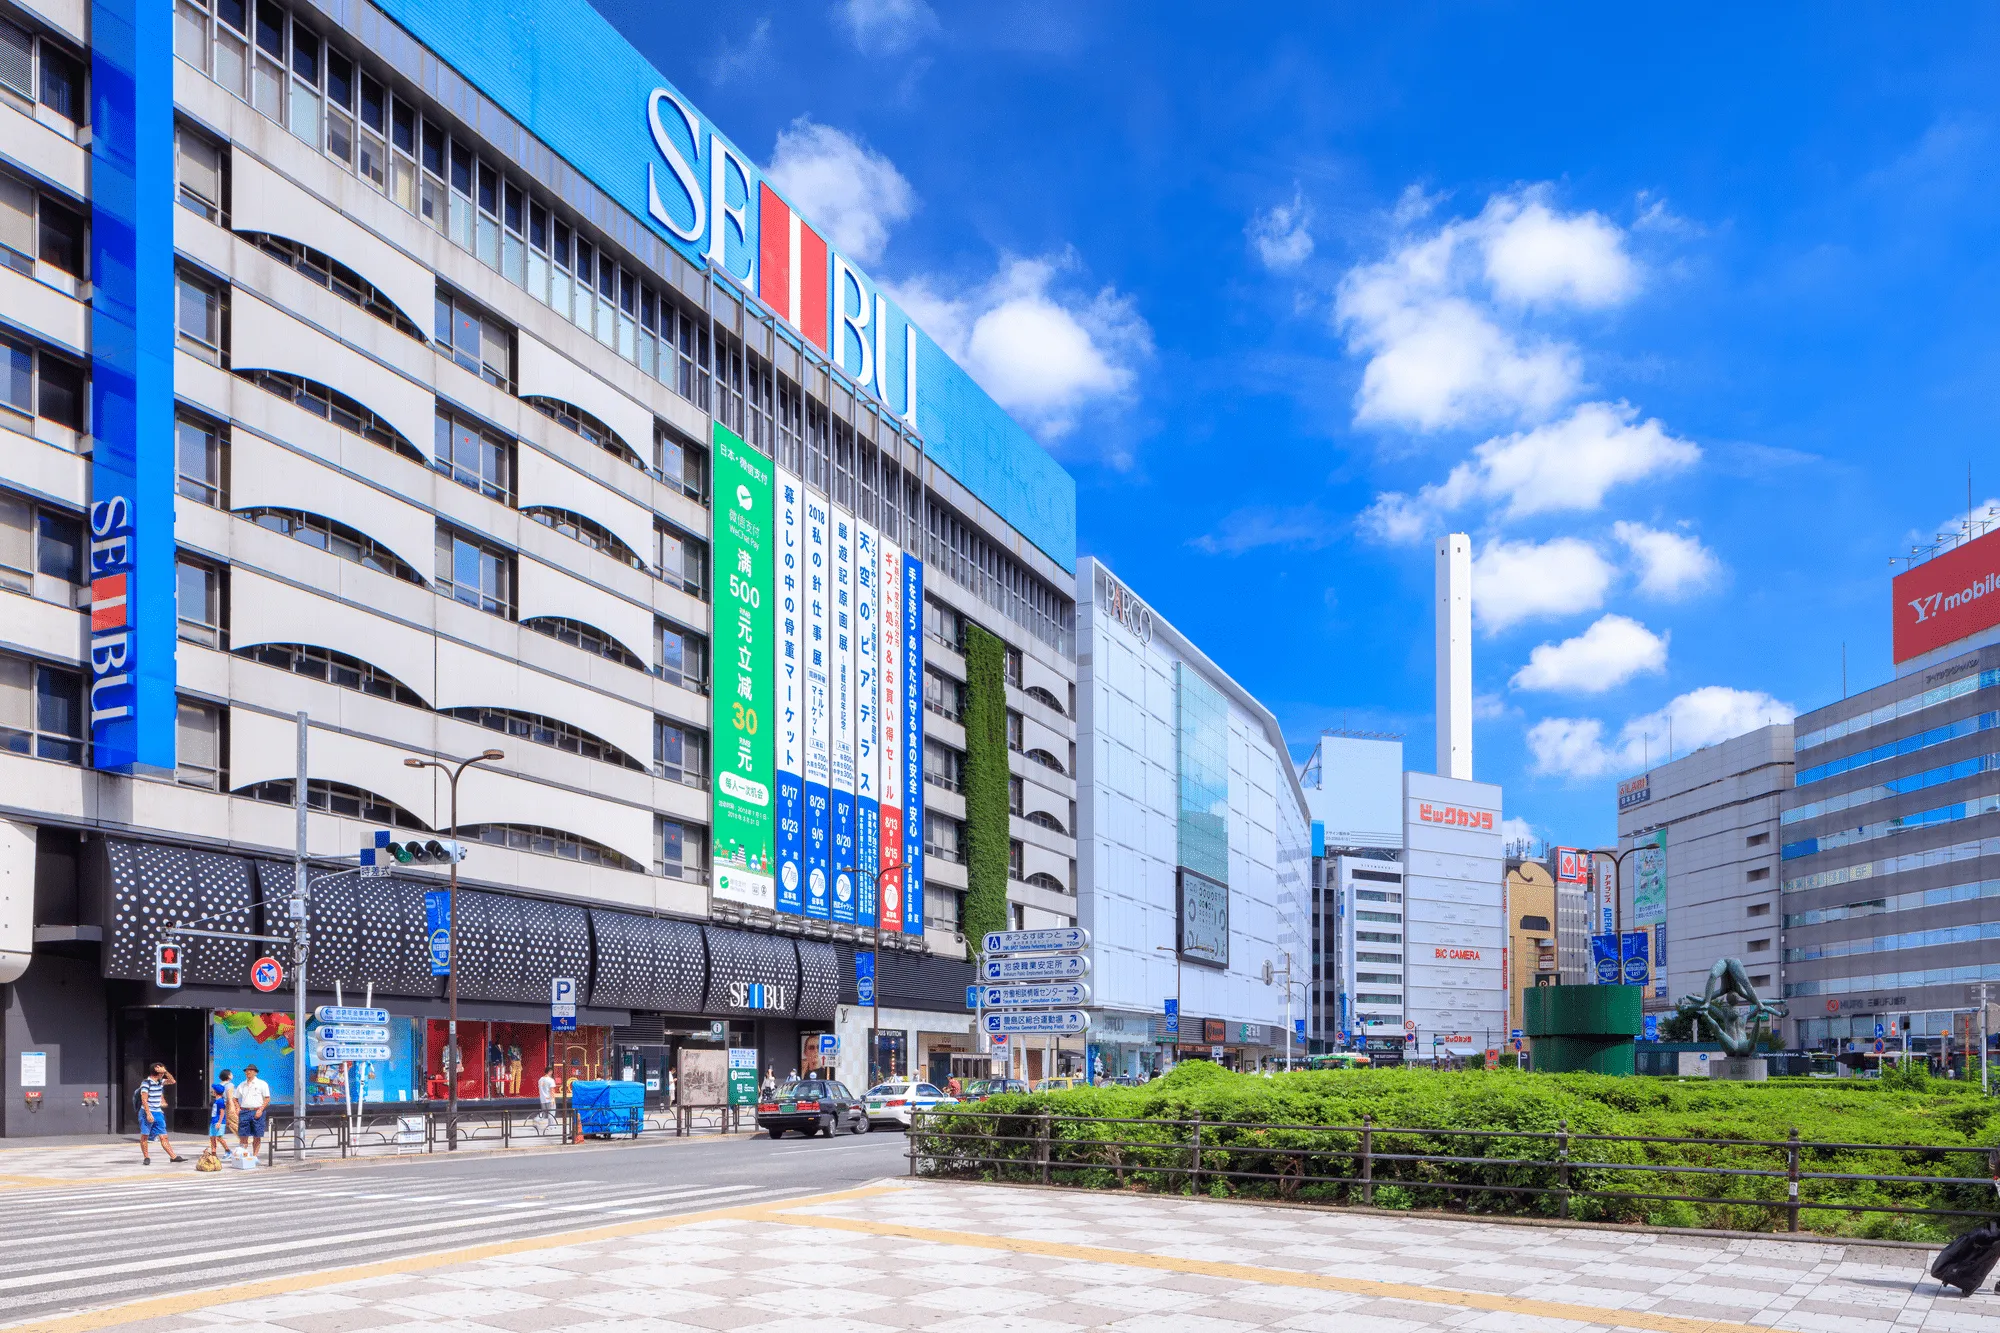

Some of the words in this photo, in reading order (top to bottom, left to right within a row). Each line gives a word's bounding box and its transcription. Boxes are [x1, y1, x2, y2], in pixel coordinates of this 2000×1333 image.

[648, 87, 918, 430] SEIBU
[91, 496, 130, 730] SEIBU
[1103, 574, 1153, 645] PARCO
[784, 485, 795, 765] 暮らしの中の骨董マーケット
[859, 531, 870, 792] 天空のビアテラス
[782, 785, 798, 800] 8/17
[810, 795, 825, 810] 8/29
[838, 803, 849, 816] 8/7
[1420, 803, 1492, 829] ビックカメラ
[782, 818, 798, 833] 8/23
[812, 827, 823, 841] 9/6
[837, 834, 851, 848] 8/20
[360, 866, 391, 876] 時差式
[1005, 931, 1061, 941] あうるすぽっと
[1435, 948, 1447, 959] BIC
[1449, 949, 1480, 960] CAMERA
[1004, 960, 1062, 971] 池袋職業安定所
[557, 981, 571, 1001] P
[730, 982, 785, 1010] SEIBU
[1003, 987, 1064, 998] 労働相談情報センター
[1004, 1014, 1063, 1024] 豊島区総合運動場
[820, 1036, 837, 1053] P
